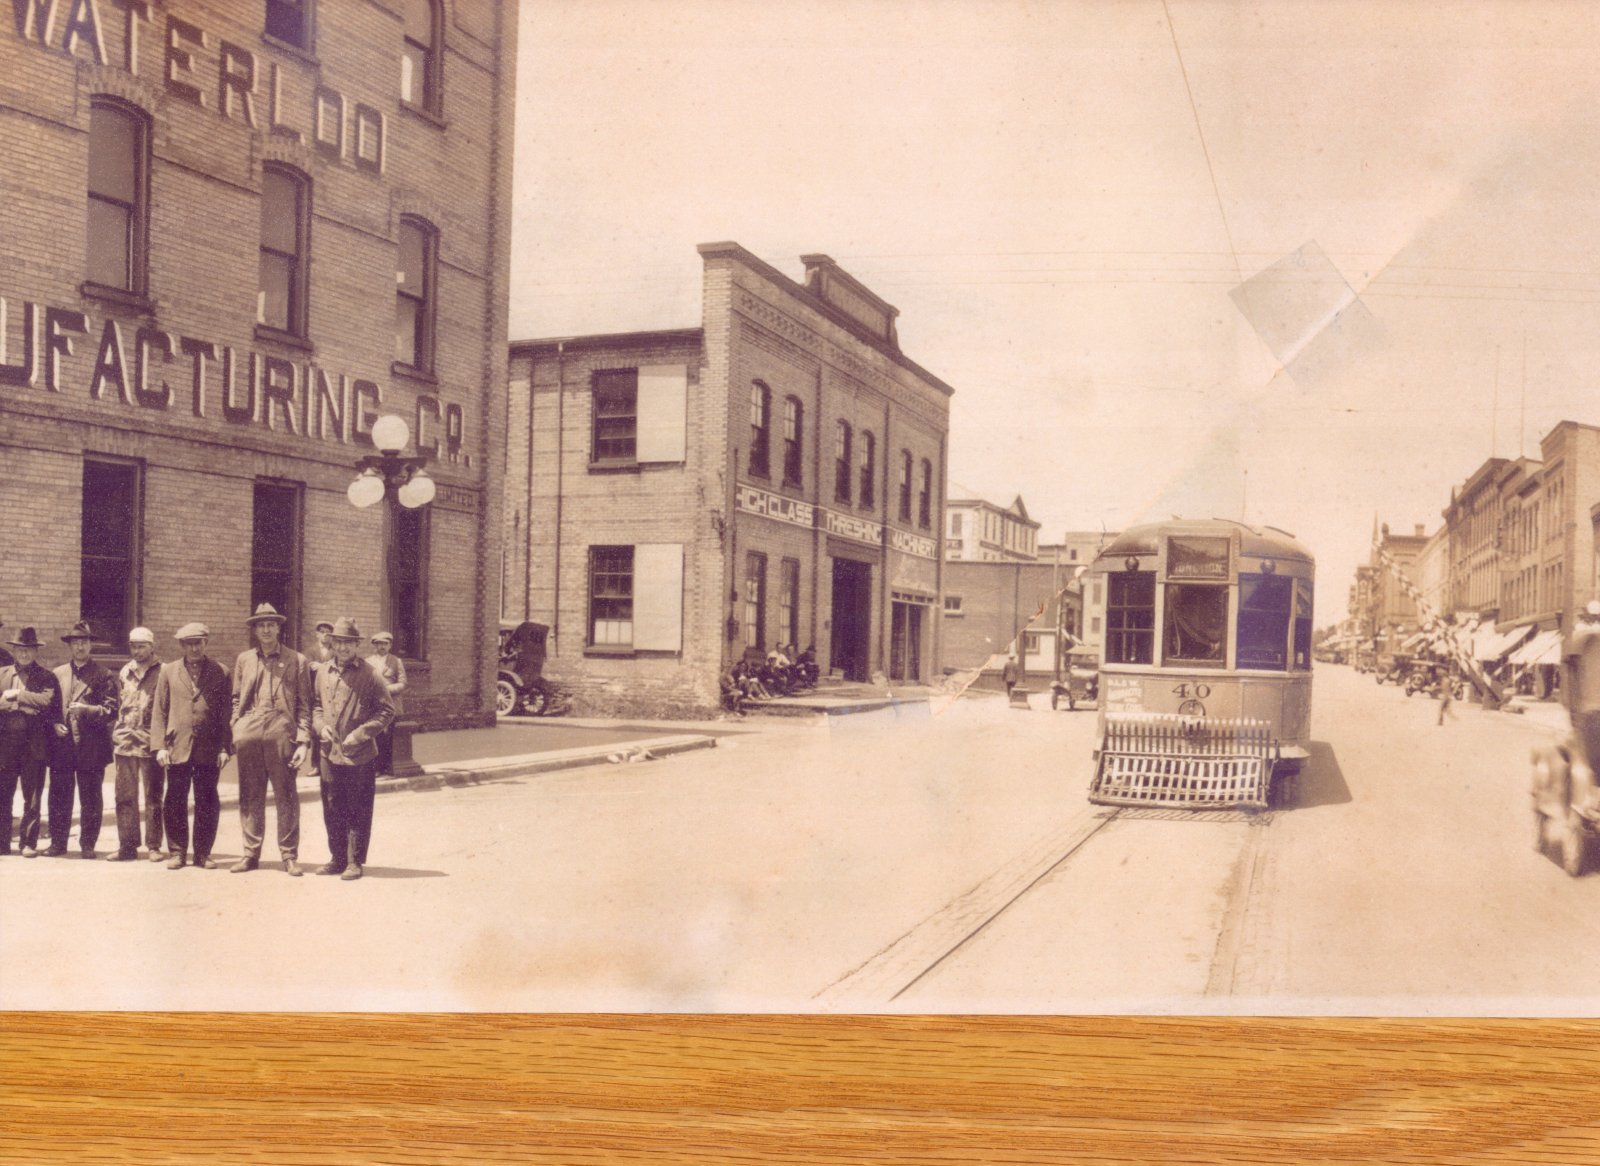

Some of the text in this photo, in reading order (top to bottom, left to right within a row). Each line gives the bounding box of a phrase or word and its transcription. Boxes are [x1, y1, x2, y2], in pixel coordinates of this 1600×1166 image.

[12, 0, 386, 175] WATERLOO
[768, 495, 813, 526] CLASS
[1171, 683, 1211, 699] 40
